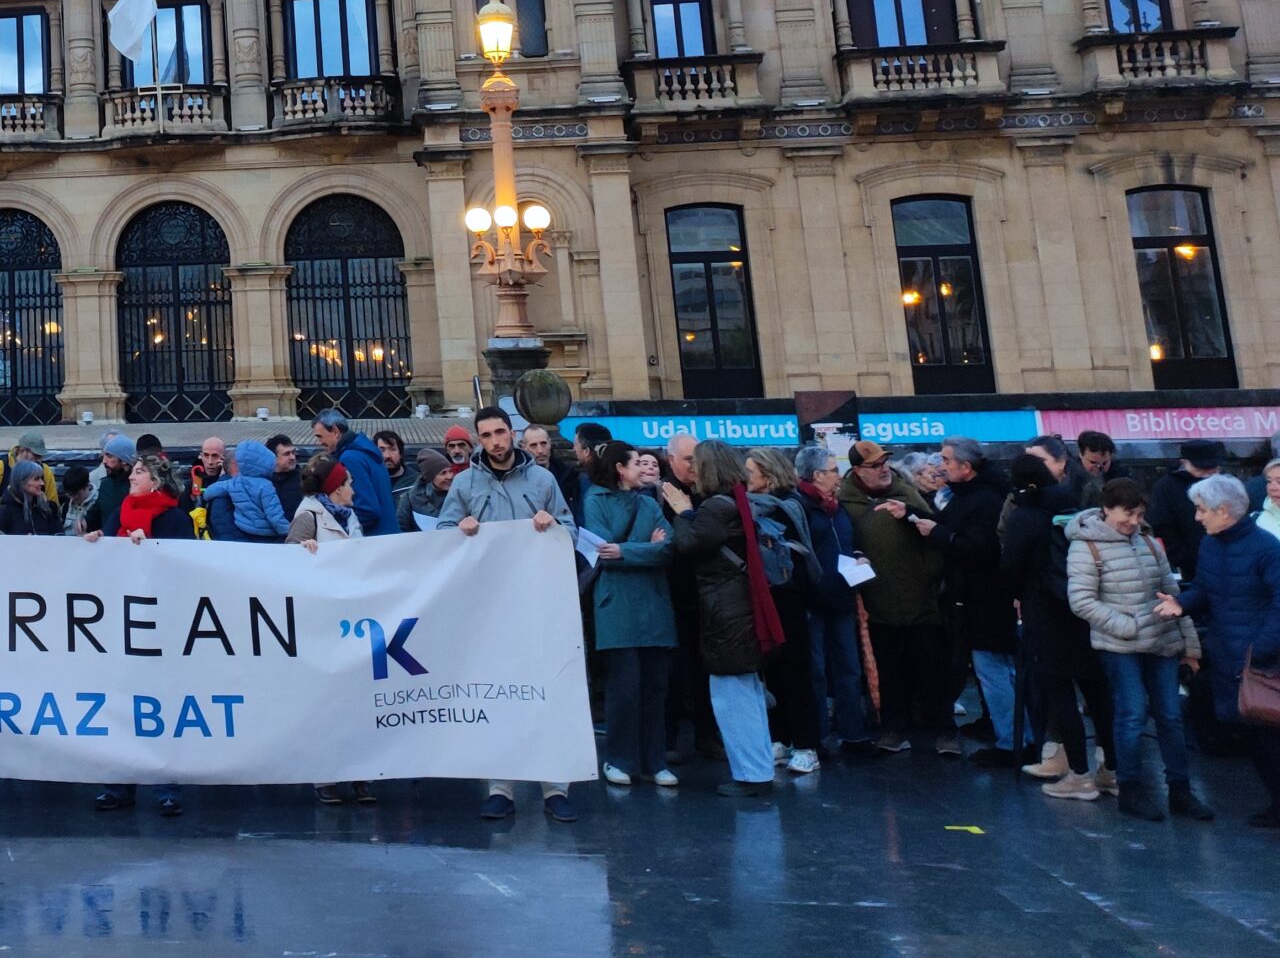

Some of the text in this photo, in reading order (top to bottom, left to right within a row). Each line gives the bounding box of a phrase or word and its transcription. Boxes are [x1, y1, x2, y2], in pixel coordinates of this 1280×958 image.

[642, 417, 945, 442] Udal Liburut agusia
[1125, 411, 1246, 433] Biblioteca
[374, 683, 546, 707] EUSKALGINTZAREN
[133, 694, 244, 738] BAT
[375, 708, 489, 729] KONTSEILUA
